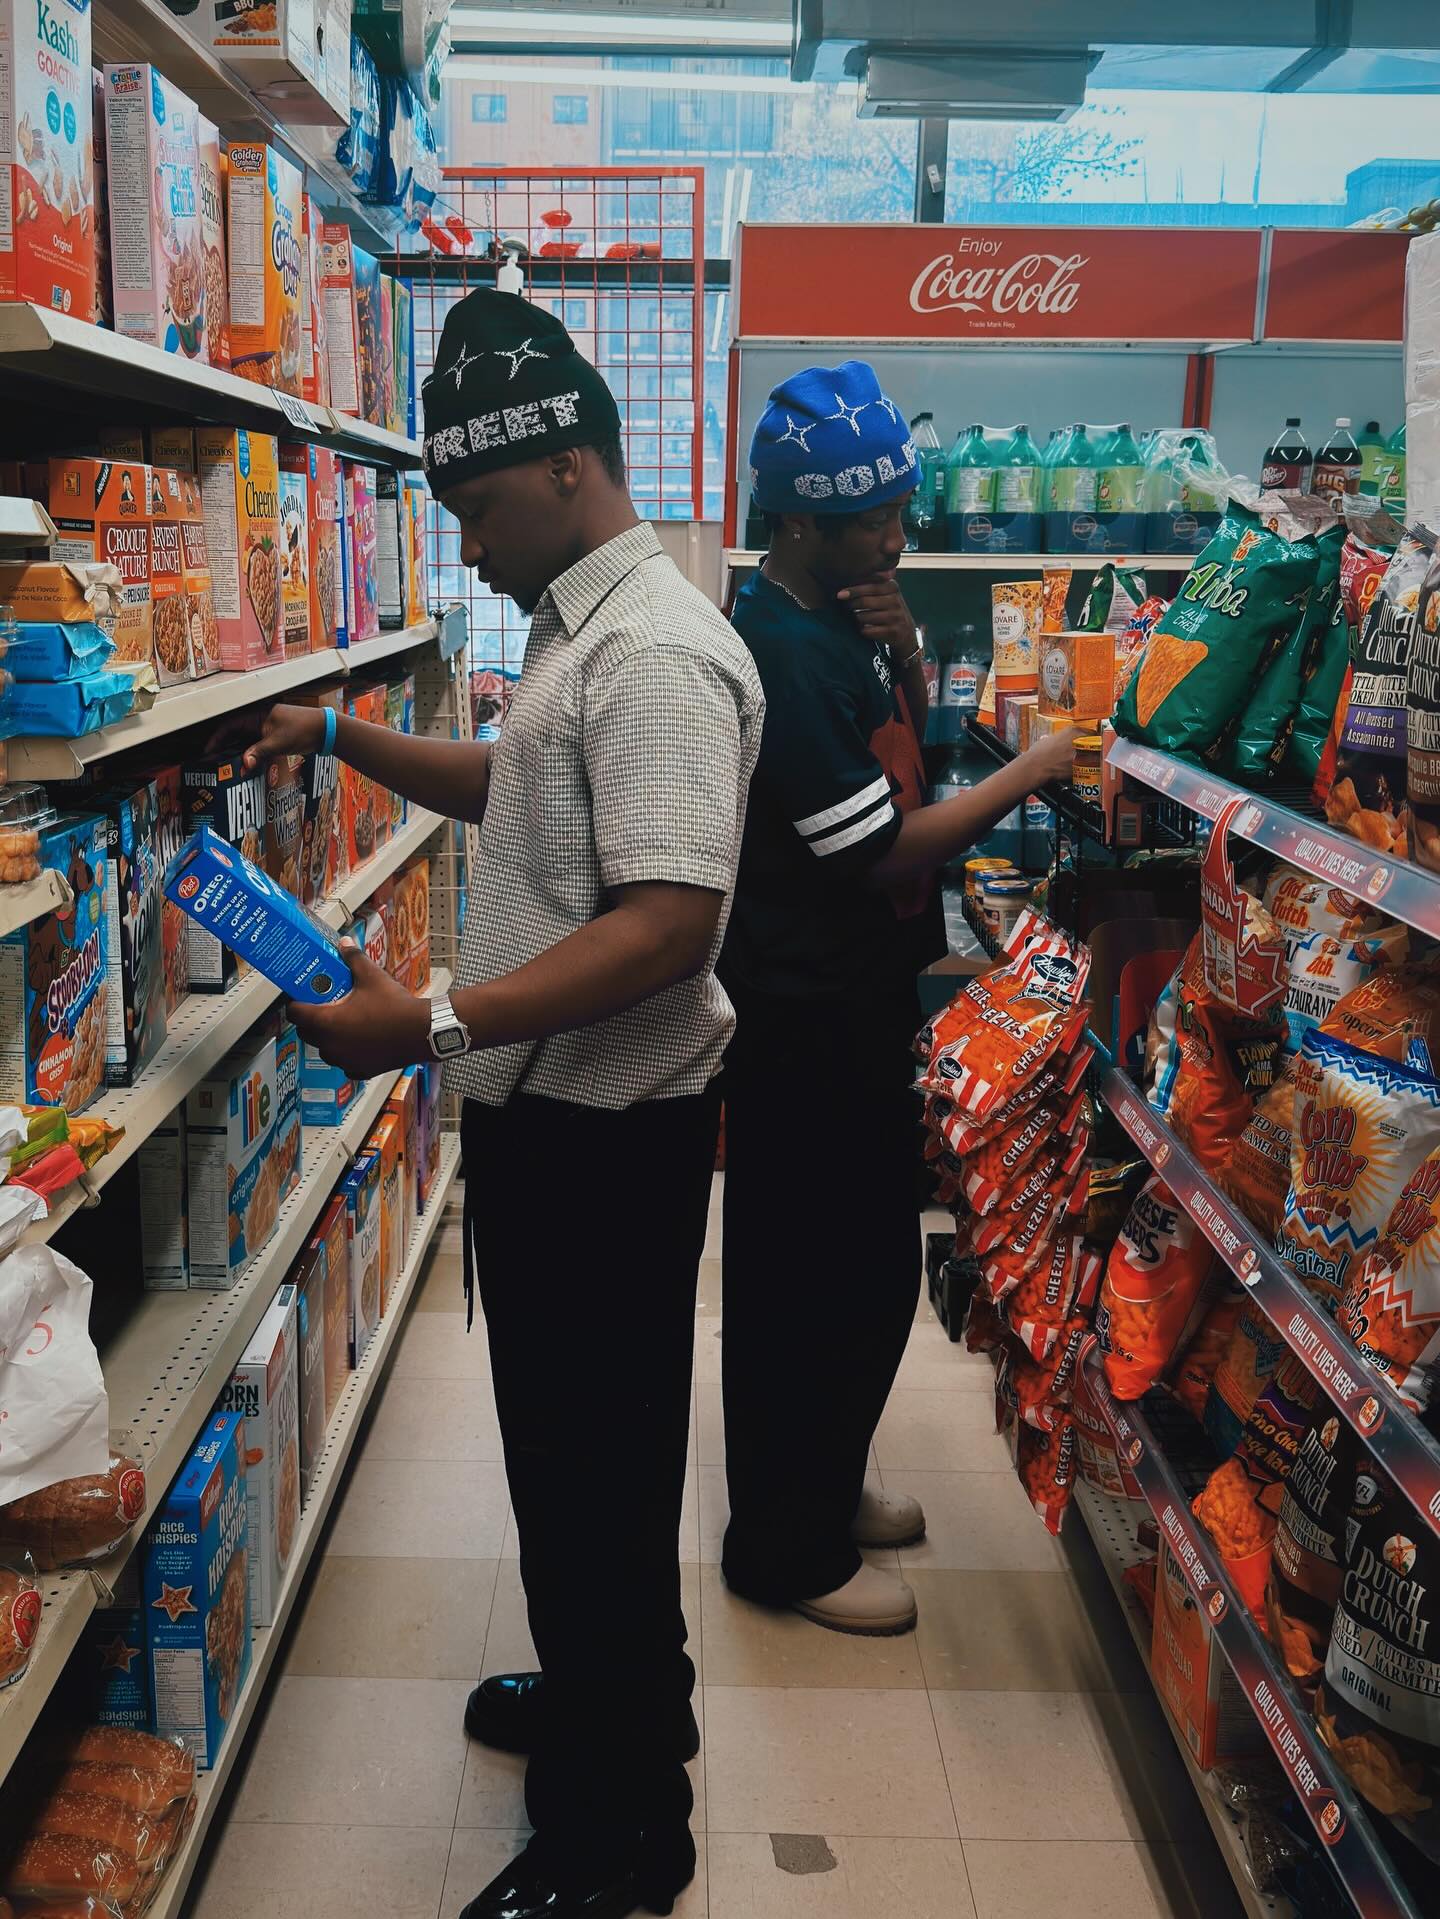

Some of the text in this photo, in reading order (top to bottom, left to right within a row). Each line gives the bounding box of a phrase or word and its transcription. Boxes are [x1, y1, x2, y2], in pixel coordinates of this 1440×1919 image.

[37, 0, 79, 66] Kashi
[37, 50, 80, 94] GOACTIV
[111, 70, 141, 84] Croque
[114, 83, 142, 94] Fraise
[231, 149, 263, 163] Golden
[53, 233, 74, 254] Original
[959, 237, 1003, 256] Enjoy
[909, 254, 1091, 314] Coca-Cola
[969, 320, 1016, 328] Trade Mark Reg.
[198, 447, 232, 457] Cheerios
[107, 527, 147, 555] CROQUE
[8, 585, 60, 594] Coconut Flavour
[154, 584, 177, 593] ORIGINAL
[1354, 710, 1365, 724] All
[185, 772, 217, 787] VECTOR
[1294, 838, 1361, 884] QUALITY LIVES HERE
[180, 878, 196, 896] Post
[193, 874, 224, 913] OREO
[210, 877, 232, 908] PUFFS
[235, 894, 249, 909] WITH
[1280, 876, 1306, 900] Old
[212, 890, 244, 923] WAKING UP IS
[230, 905, 247, 927] OREO
[232, 906, 263, 940] LE EST
[256, 910, 269, 924] AVEC
[1272, 895, 1309, 929] Dutch
[250, 920, 267, 943] OREO
[294, 958, 320, 985] REAL OREO
[1034, 956, 1077, 983] Hawkins
[38, 1044, 74, 1074] CINNAMON
[1012, 1023, 1064, 1076] CHEEZIES
[48, 1064, 66, 1082] CRISP
[1299, 1060, 1314, 1077] Old
[1295, 1074, 1319, 1098] Dutch
[242, 1070, 271, 1149] life
[1119, 1099, 1157, 1149] QUALITY LIVES HERE
[1002, 1108, 1052, 1167] CHEEZIES
[231, 1167, 258, 1205] original
[1010, 1157, 1056, 1212] CHEEZIES
[1011, 1191, 1053, 1253] CHEEZIES
[1190, 1190, 1242, 1256] QUALITY LIVES HERE
[1046, 1236, 1067, 1305] CHEEZIES
[1274, 1226, 1352, 1289] Original
[1052, 1329, 1083, 1393] CHEEZIES
[1288, 1313, 1357, 1401] QUALITY LIVES HERE
[1114, 1409, 1131, 1440] HERE
[1055, 1424, 1074, 1486] CHEEZIES
[1302, 1427, 1338, 1488] DUTCH
[122, 1473, 138, 1489] Natural
[1161, 1504, 1185, 1545] QUALITY
[1178, 1534, 1197, 1565] LIVES
[1191, 1557, 1210, 1592] HERE
[1357, 1546, 1427, 1618] DUTCH
[15, 1594, 31, 1619] Natural
[1343, 1569, 1430, 1652] CRUNCH
[1160, 1615, 1194, 1684] CHEDDAR
[1377, 1639, 1426, 1676] CUITES
[1341, 1666, 1392, 1713] ORIGINAL
[1253, 1680, 1318, 1797] QUALITY LIVES HERE
